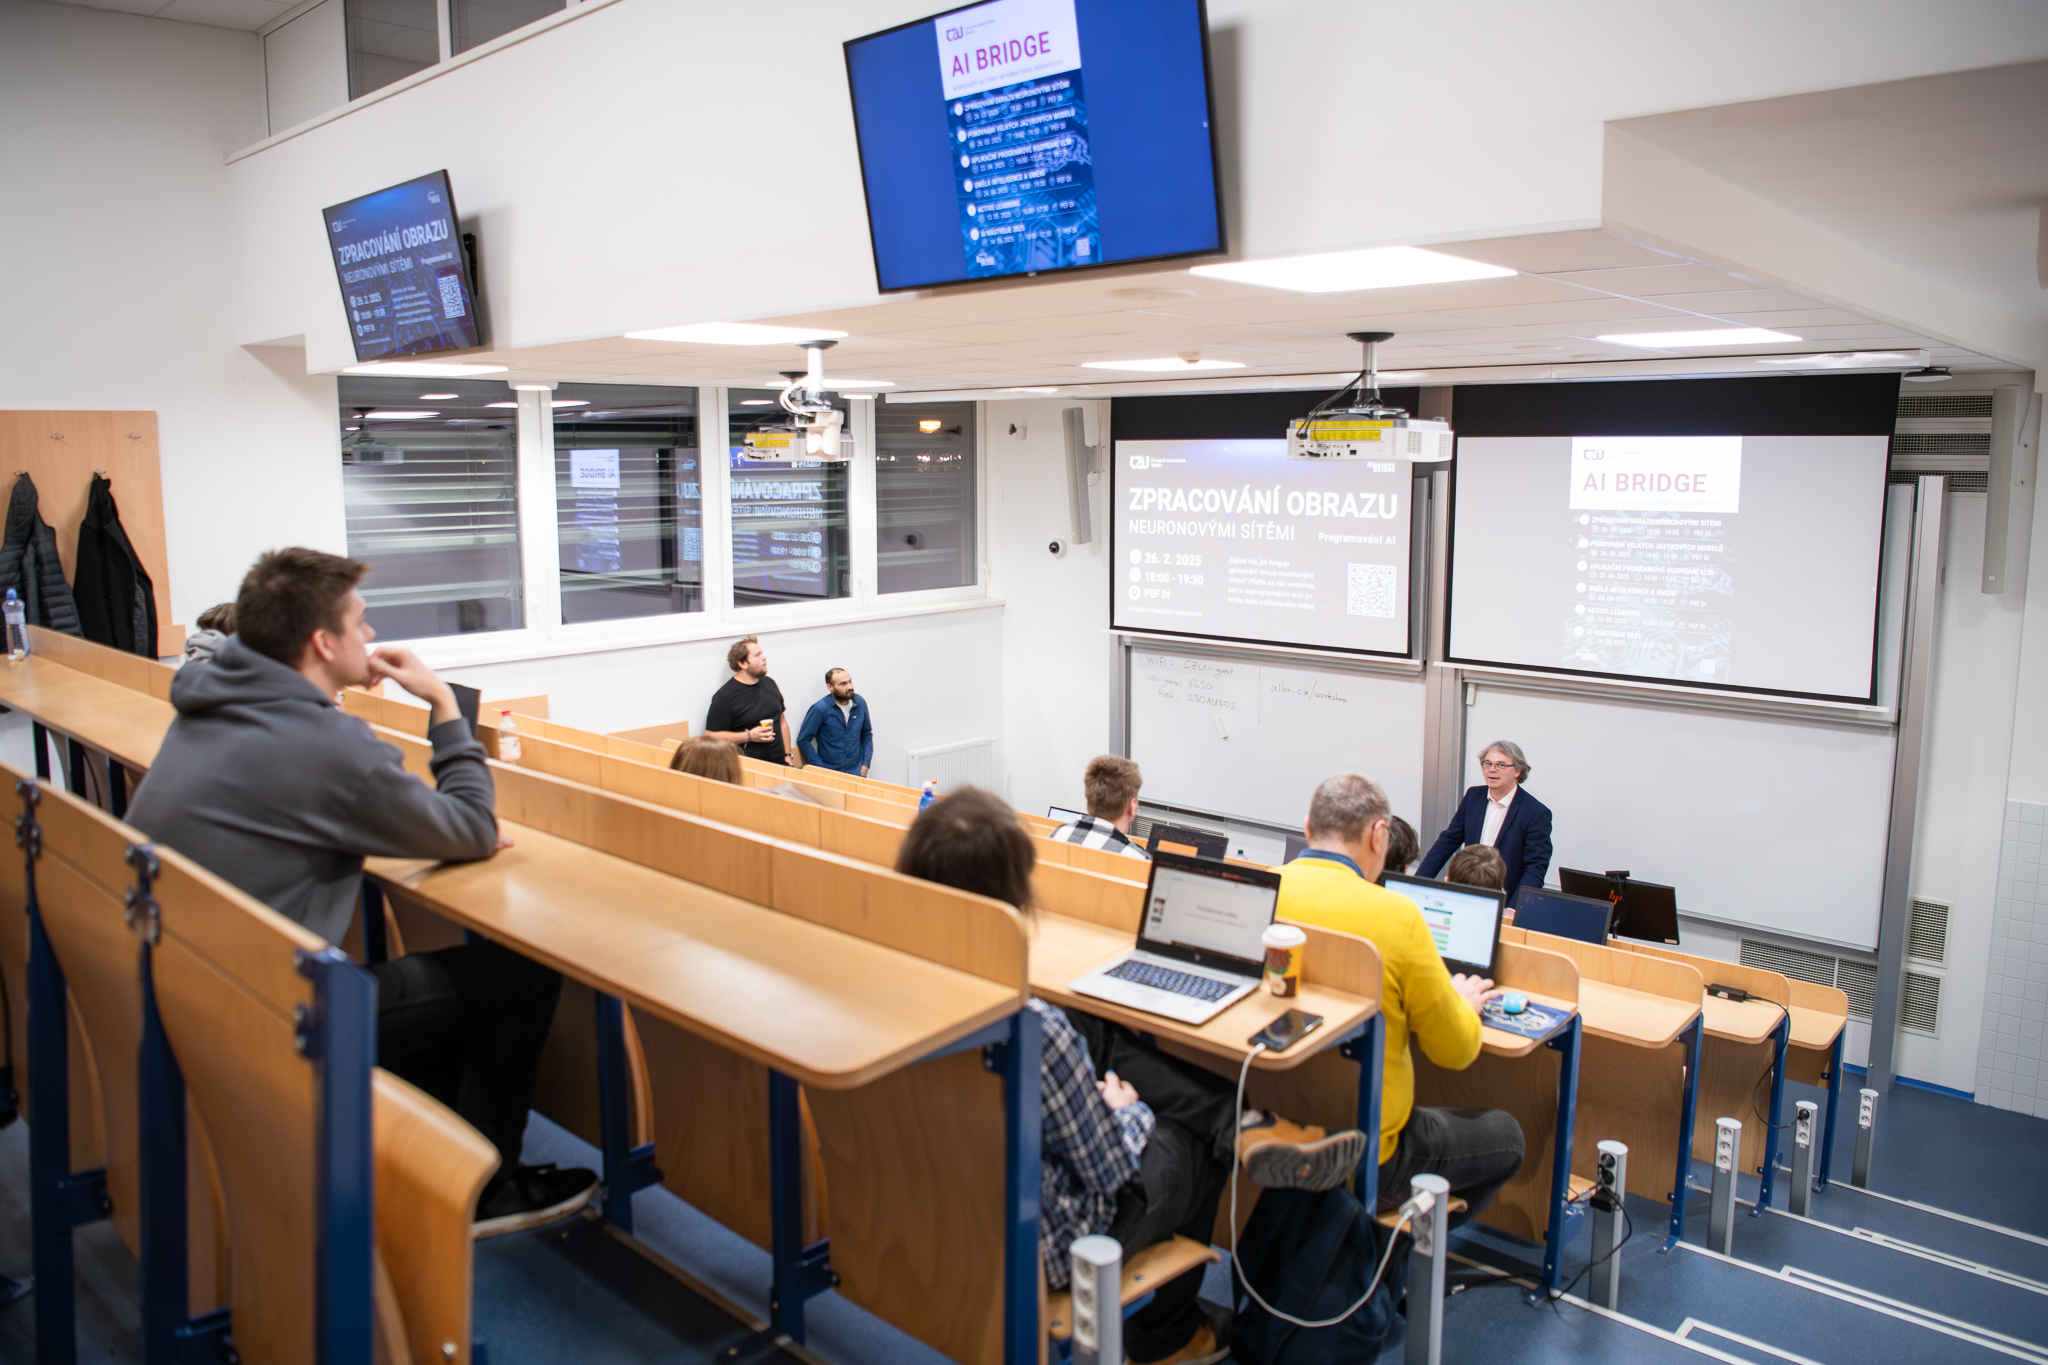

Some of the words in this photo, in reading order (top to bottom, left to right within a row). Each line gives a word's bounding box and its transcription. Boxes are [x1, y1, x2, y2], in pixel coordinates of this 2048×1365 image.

[952, 53, 970, 78] AI
[976, 31, 1050, 70] BRIDGE
[338, 226, 402, 265] ZPRACOVÁNÍ
[402, 219, 448, 249] OBRAZU
[1373, 462, 1396, 473] BRIDGE
[1582, 473, 1606, 492] AI
[1615, 473, 1706, 493] BRIDGE
[1129, 484, 1281, 515] ZPRACOVÁNÍ
[1286, 491, 1398, 519] OBRAZU
[1655, 518, 1699, 526] NEURONOVÝMI
[1700, 518, 1721, 527] SÍTĚMI
[1129, 519, 1235, 538] NEURONOVÝMI
[1240, 520, 1294, 540] SÍTĚMI
[1318, 532, 1383, 544] Programování
[1385, 536, 1395, 545] AI
[1145, 552, 1160, 564] 26.
[1163, 554, 1172, 565] 2.
[1176, 554, 1202, 566] 2025
[1623, 565, 1666, 573] PROGRAMOVÉ
[1145, 572, 1169, 583] 18:00
[1178, 574, 1204, 585] 19:30
[1144, 588, 1160, 598] PEF
[1161, 590, 1170, 599] DI
[1188, 679, 1212, 690] 8650
